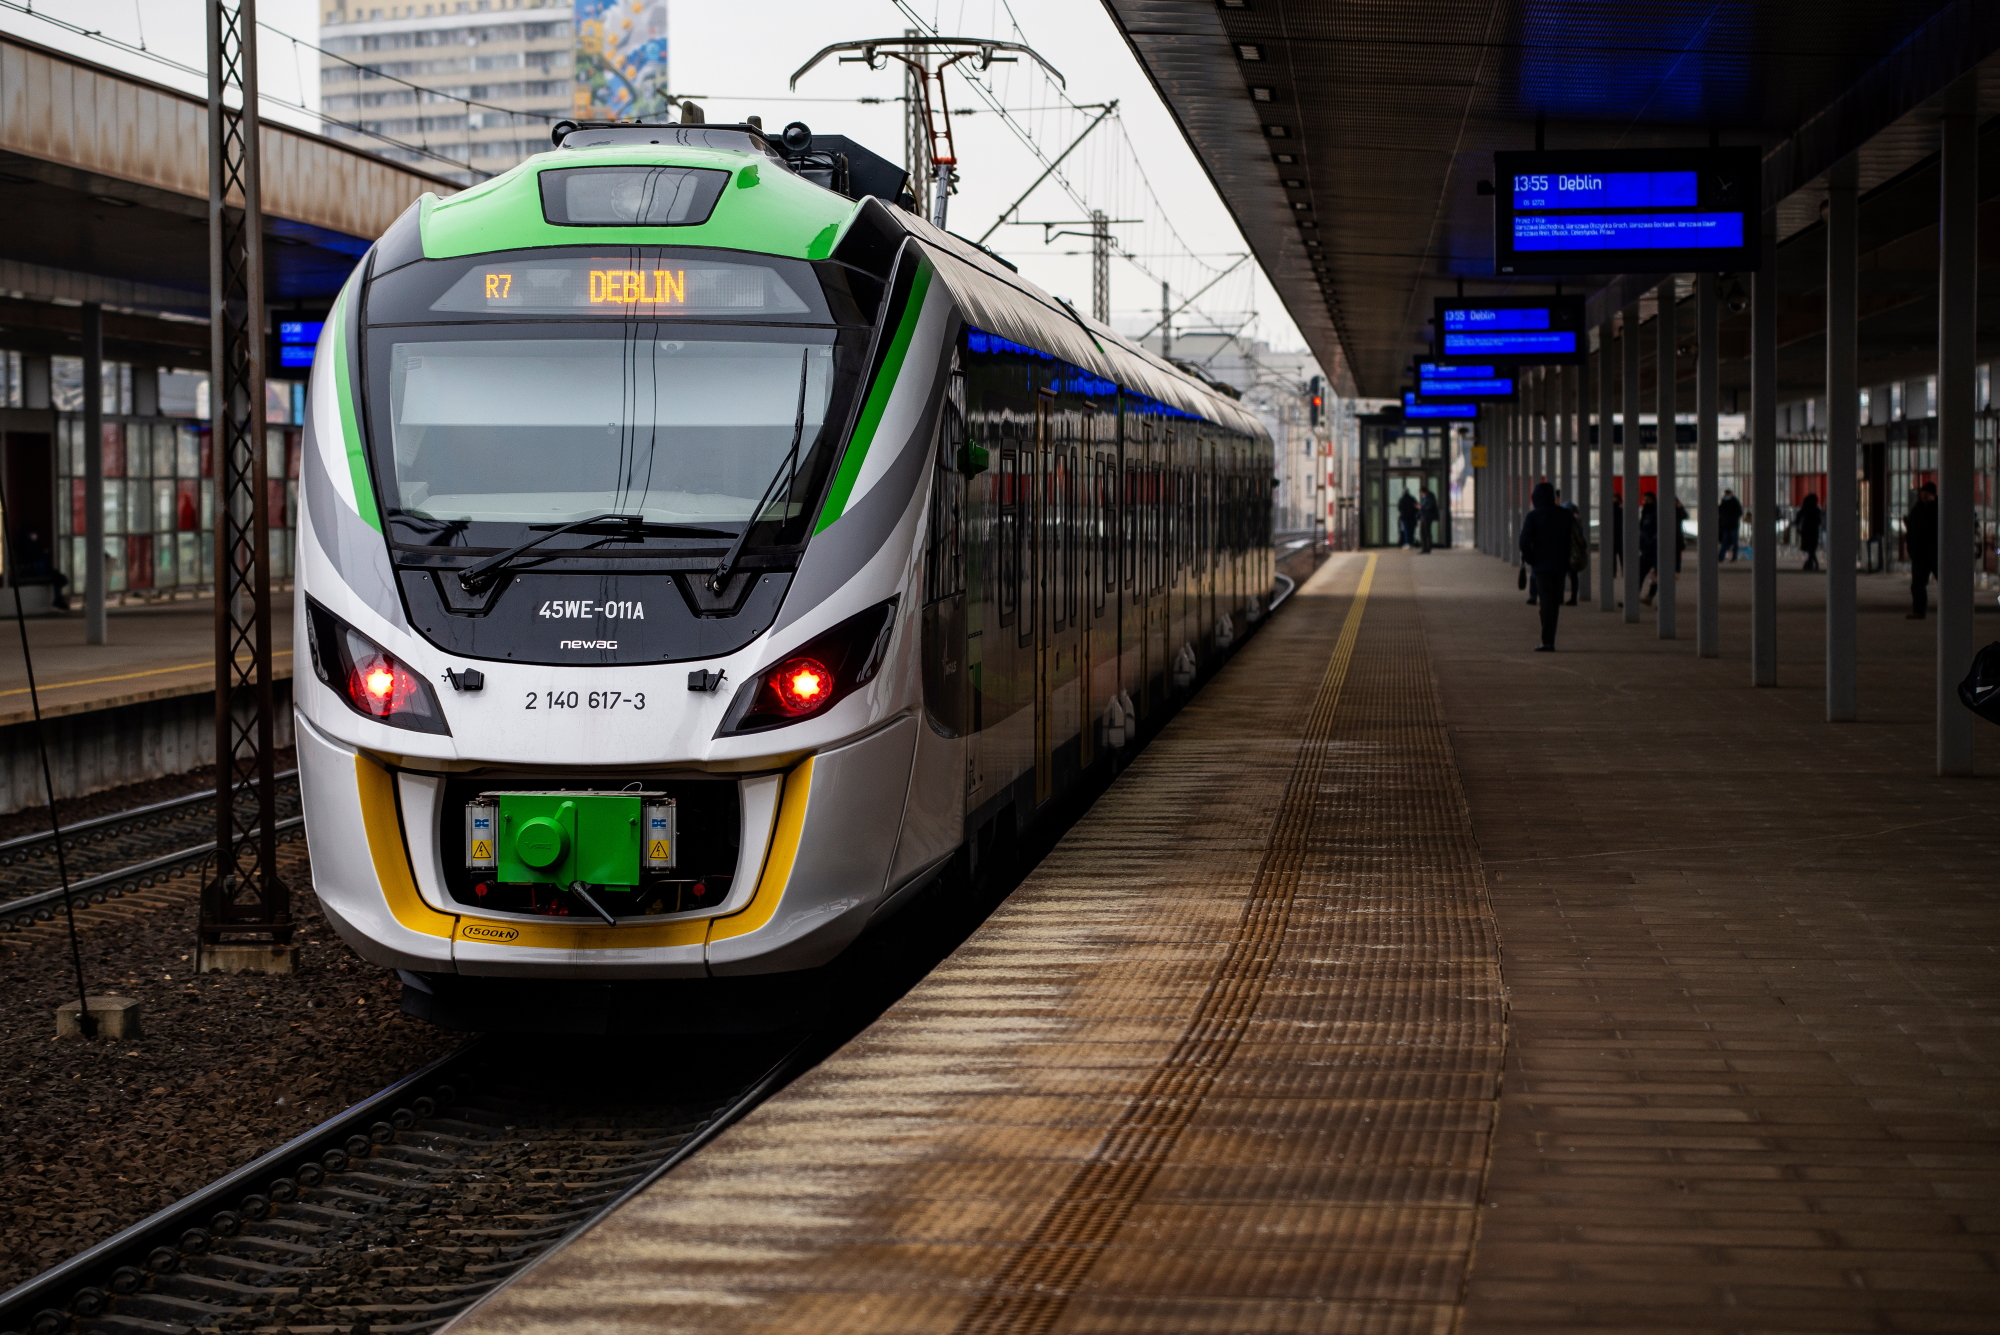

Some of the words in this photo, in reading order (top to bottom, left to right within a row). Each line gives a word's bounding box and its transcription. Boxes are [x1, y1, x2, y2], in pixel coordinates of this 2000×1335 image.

[1514, 175, 1548, 191] 13:55
[1559, 174, 1602, 192] Dęblin
[486, 274, 512, 298] R7
[589, 270, 684, 304] DĘBLIN
[539, 600, 645, 620] 45WE-011A
[525, 691, 538, 710] 2
[546, 691, 579, 709] 140
[588, 691, 646, 710] 617-3
[468, 927, 515, 939] 1500kN
